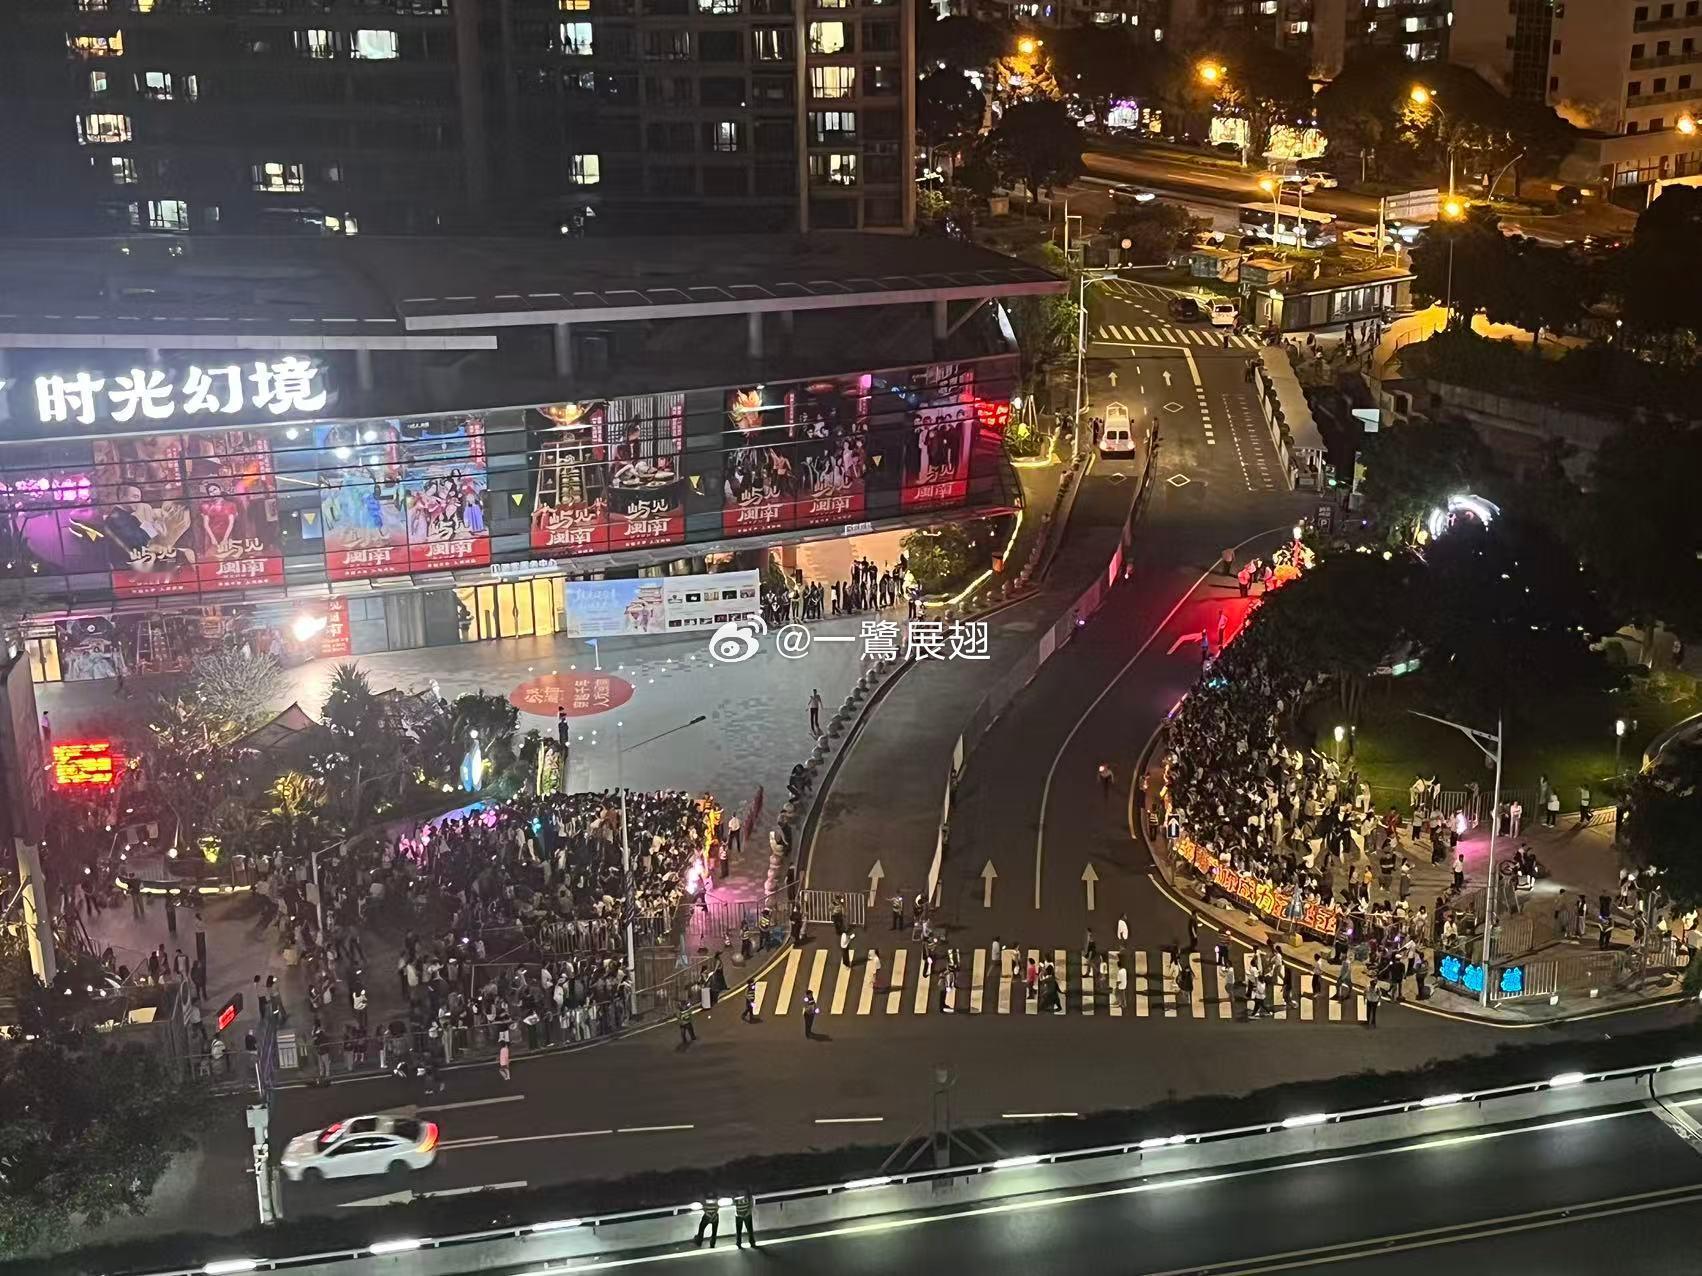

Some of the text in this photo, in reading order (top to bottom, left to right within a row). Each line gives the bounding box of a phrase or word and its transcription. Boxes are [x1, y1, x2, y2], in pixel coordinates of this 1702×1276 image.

[35, 356, 327, 424] 时光幻境
[624, 499, 669, 520] 屿见
[737, 503, 783, 522] 闽南
[809, 495, 854, 513] 闽南
[547, 508, 596, 530] 屿见
[624, 517, 672, 537] 闽南
[546, 527, 595, 546] 闽南
[343, 546, 395, 566] 闽南
[425, 540, 479, 559] 闽南
[216, 556, 268, 577] 闽南
